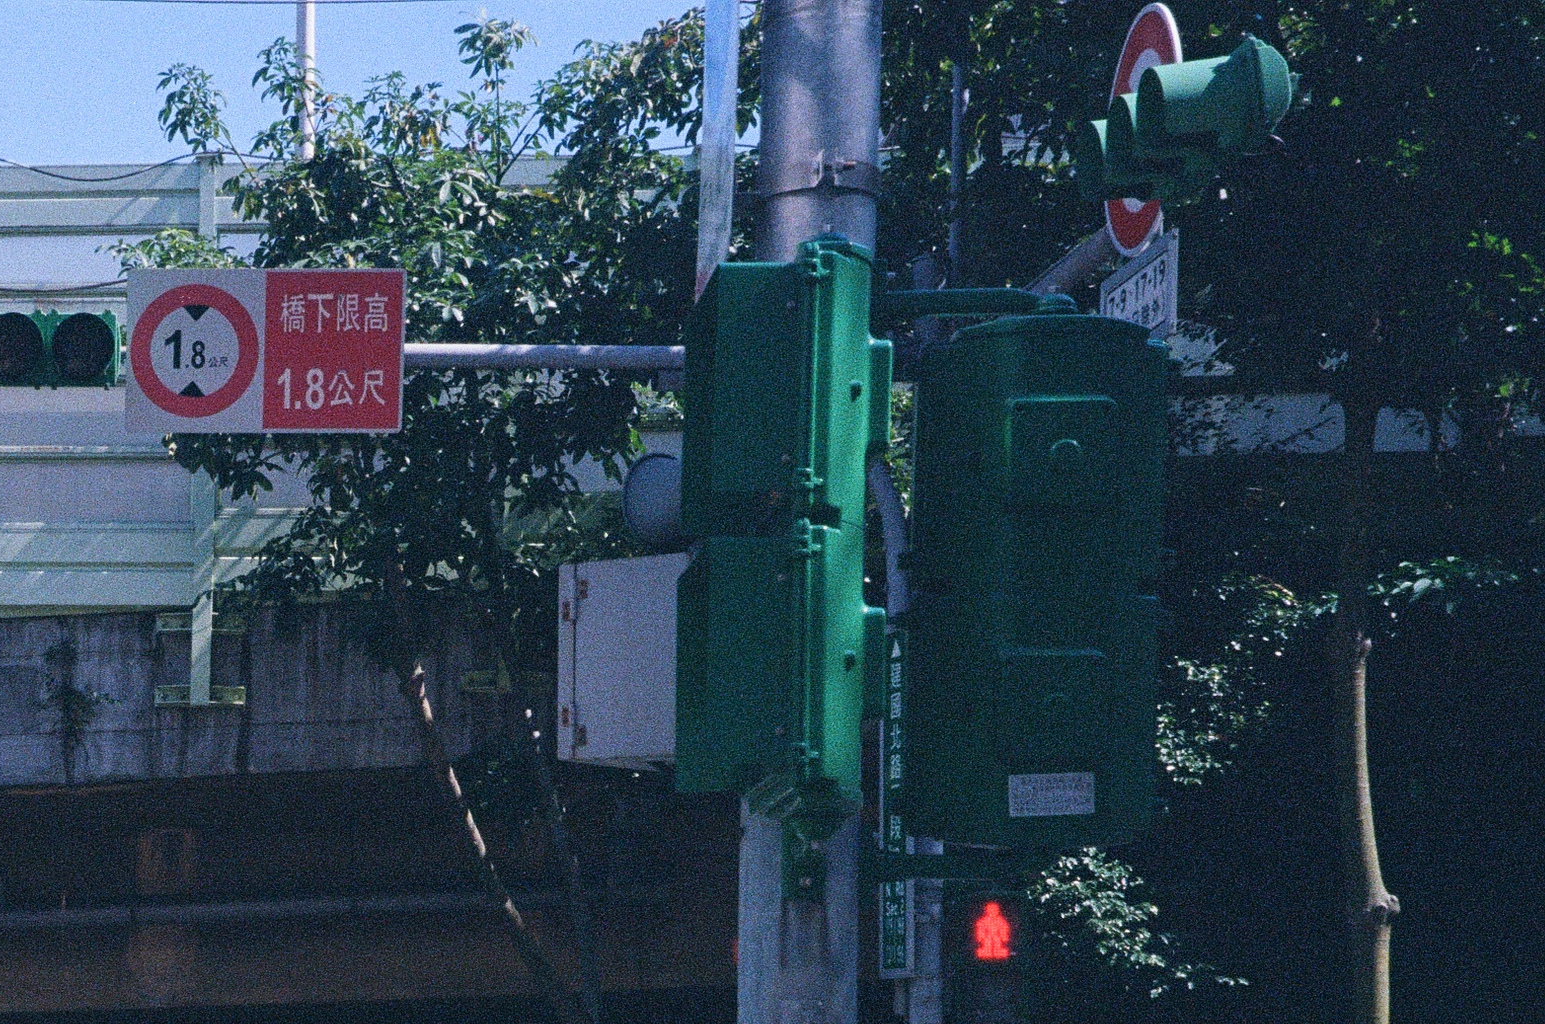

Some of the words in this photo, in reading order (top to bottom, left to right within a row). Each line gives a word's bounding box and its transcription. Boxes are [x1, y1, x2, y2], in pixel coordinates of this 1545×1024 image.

[279, 293, 388, 333] 橋下限高
[276, 367, 386, 410] 1.8公尺
